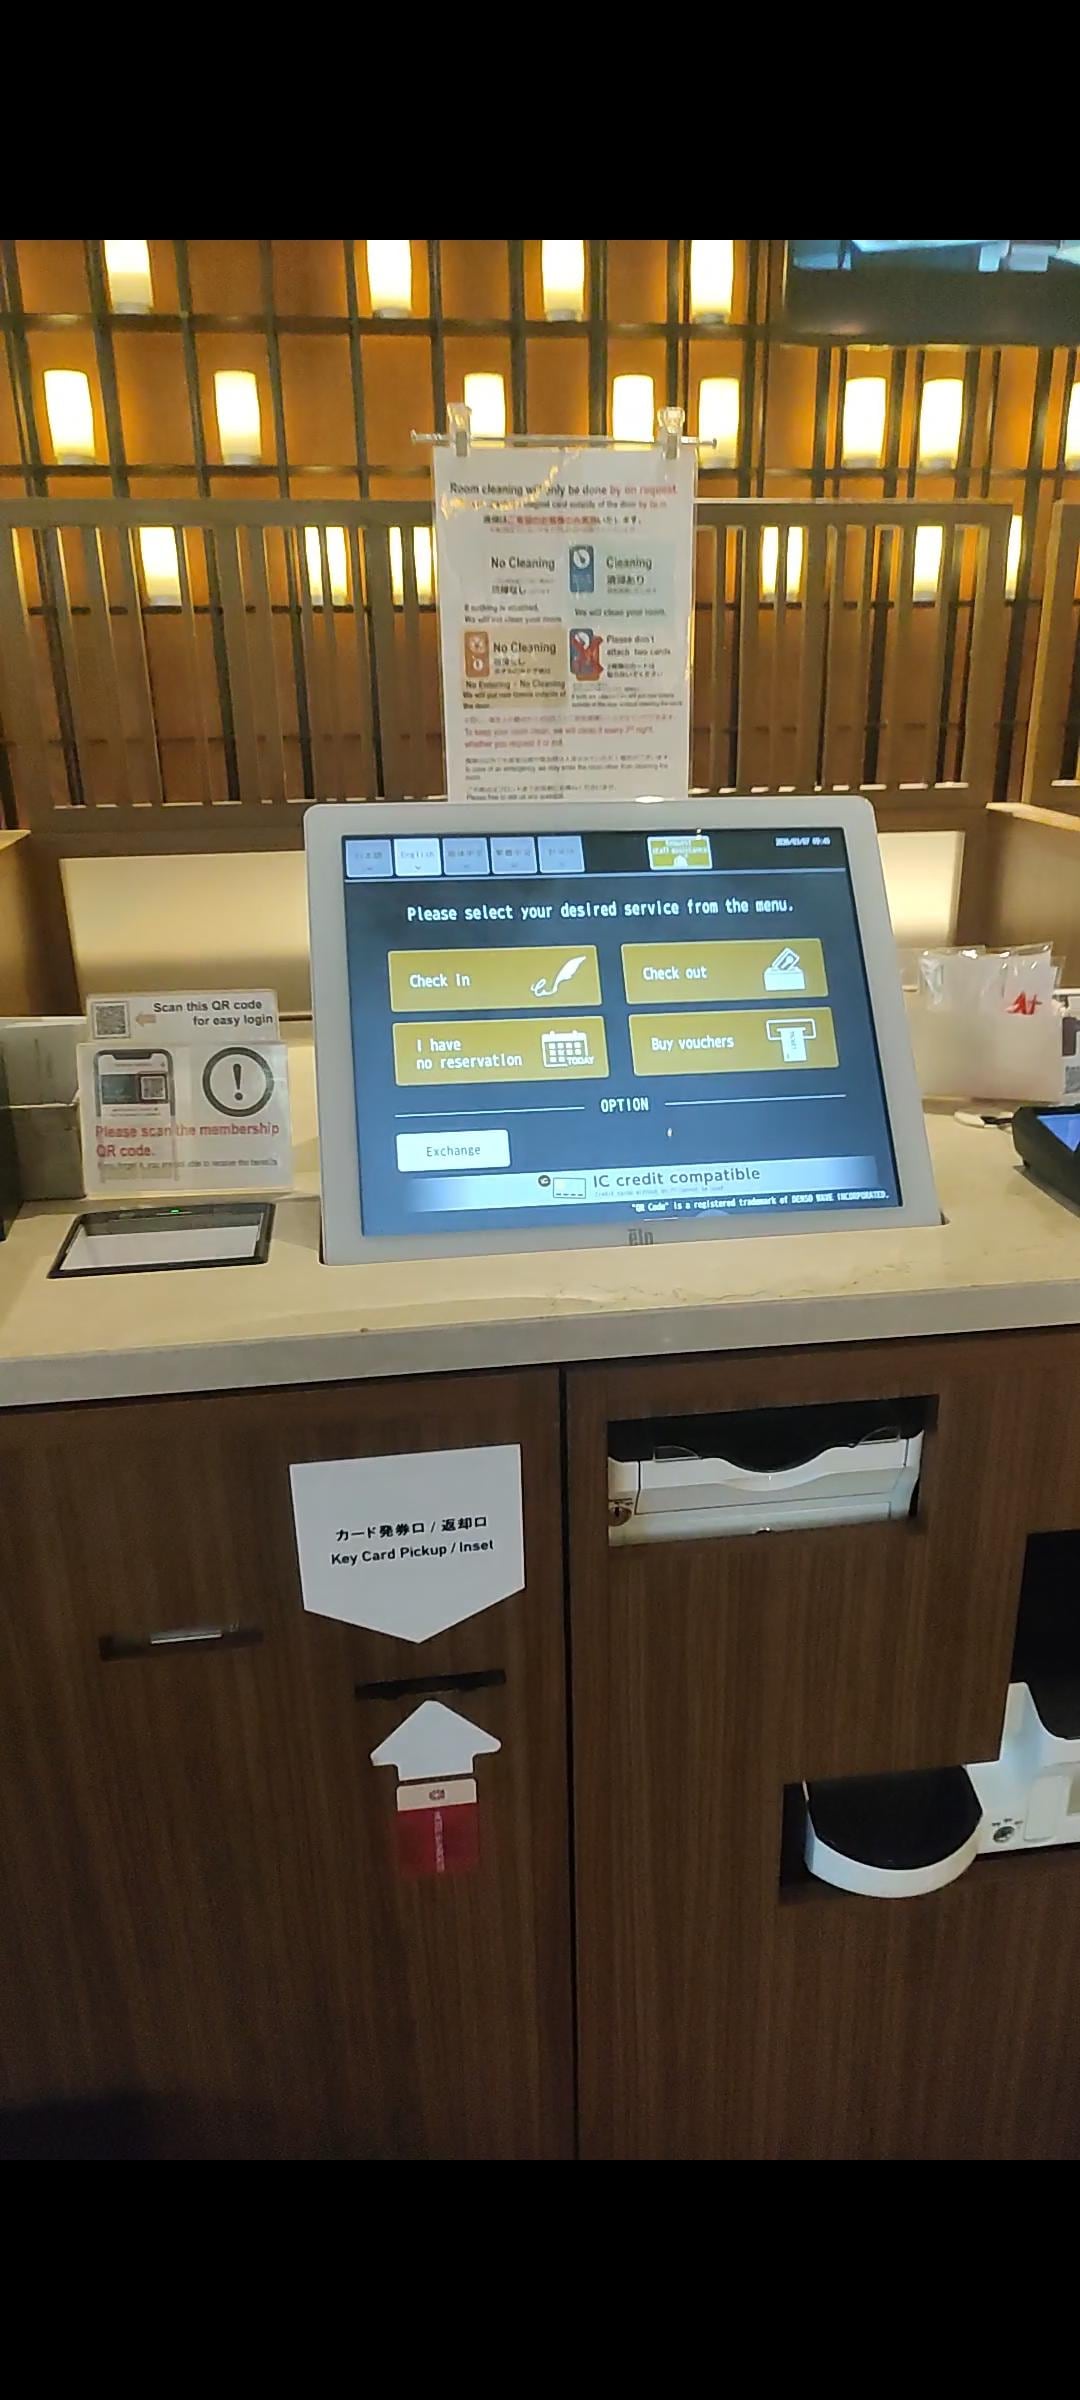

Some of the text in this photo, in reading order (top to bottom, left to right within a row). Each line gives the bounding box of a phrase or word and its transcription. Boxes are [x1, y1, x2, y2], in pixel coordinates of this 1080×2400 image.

[449, 482, 480, 495] Room
[481, 483, 523, 497] cleaning
[568, 484, 580, 495] be
[582, 484, 607, 495] done
[491, 556, 556, 572] No Cleaning
[606, 556, 653, 571] Cleaning
[606, 635, 633, 644] Please
[493, 642, 557, 656] No Cleaning
[606, 648, 631, 657] attach
[533, 681, 566, 691] Cleaning
[407, 897, 794, 922] Please select your desired service from the menu.
[409, 972, 447, 989] Check
[642, 965, 708, 982] Check out
[154, 1000, 263, 1013] Scan this QR code
[193, 1013, 274, 1027] for easy login
[429, 1036, 462, 1053] have
[651, 1032, 735, 1051] Buy vouchers
[416, 1053, 523, 1070] no reservation
[567, 1056, 594, 1065] TODAY
[600, 1096, 650, 1113] OPTION
[95, 1120, 280, 1139] Please scan the membership
[96, 1143, 156, 1158] QR code.
[426, 1143, 481, 1159] Exchange
[594, 1166, 761, 1188] IC credit compatible
[674, 1201, 682, 1210] is
[694, 1199, 737, 1209] registered
[739, 1197, 777, 1208] trademark
[779, 1197, 788, 1206] of
[336, 1522, 425, 1542] カード発券口
[441, 1516, 488, 1533] 返却口
[331, 1553, 358, 1566] Key
[362, 1549, 396, 1563] Card
[400, 1545, 448, 1559] Pickup
